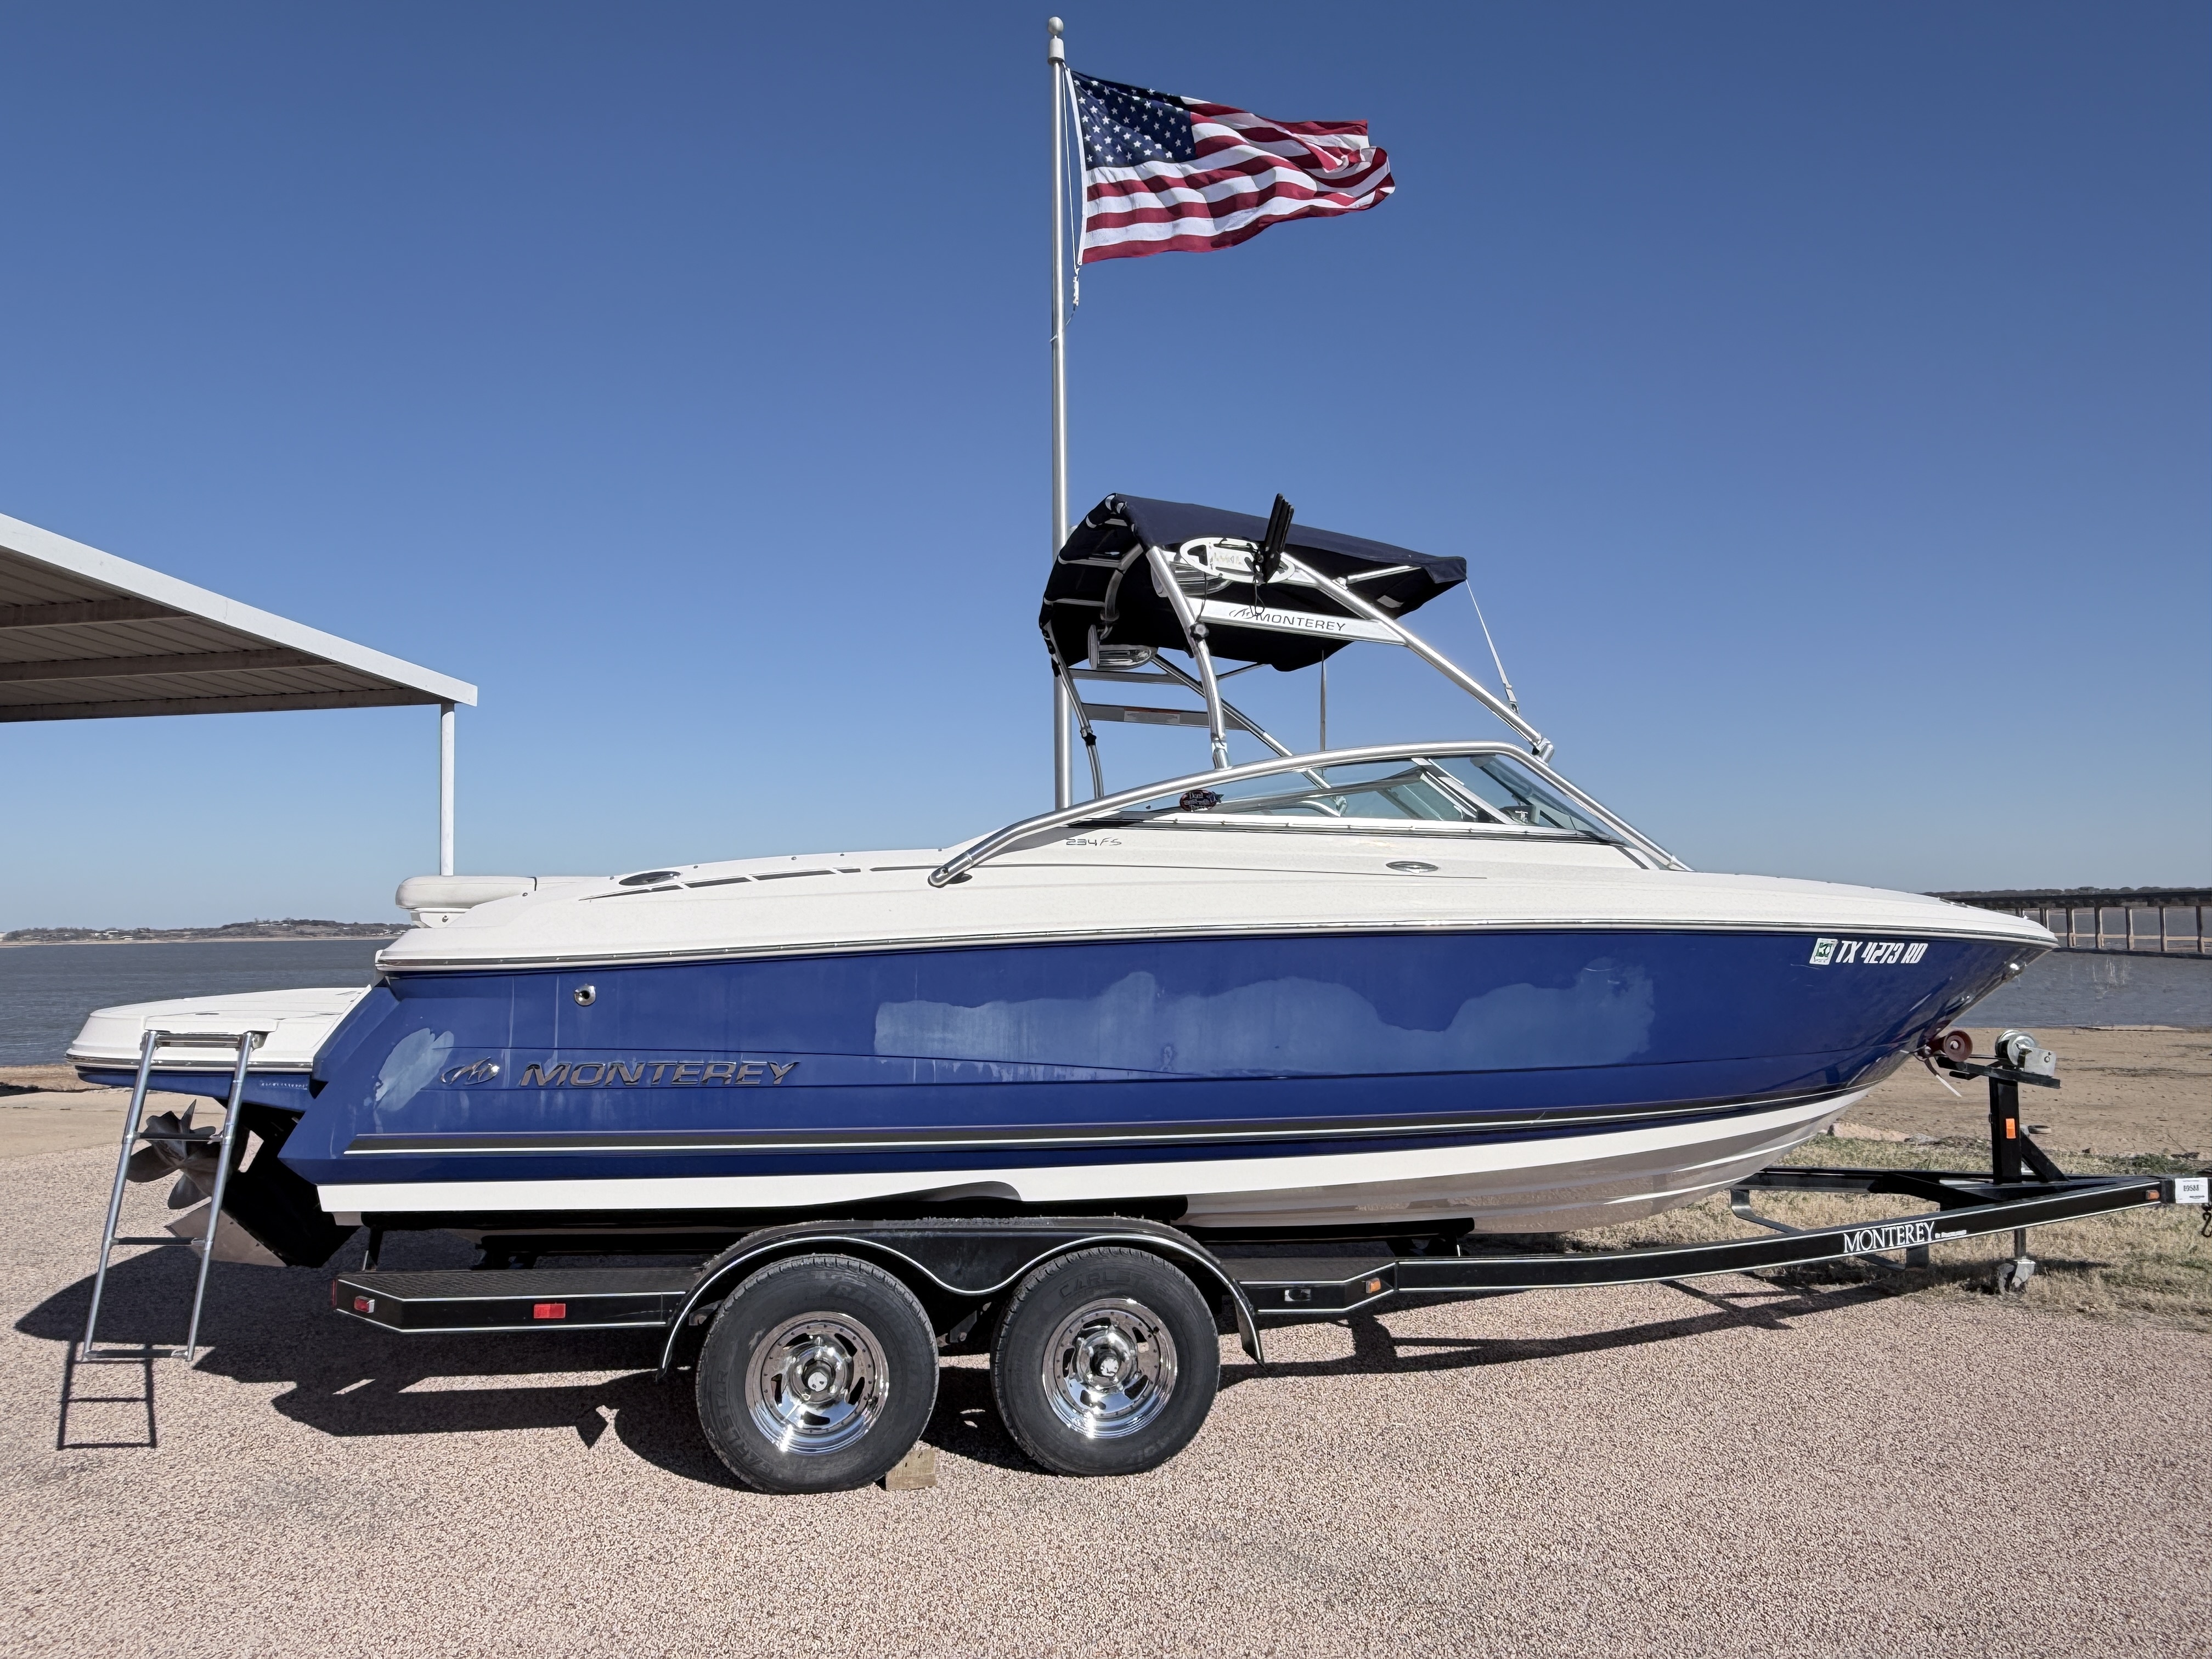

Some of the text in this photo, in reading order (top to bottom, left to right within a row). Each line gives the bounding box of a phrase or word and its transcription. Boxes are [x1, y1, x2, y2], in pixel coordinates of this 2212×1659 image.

[1255, 613, 1346, 631] MONTEREY
[1836, 940, 1863, 963] TX
[1861, 942, 1905, 964] 4273
[520, 1062, 800, 1087] MONTEREY
[1843, 1221, 1935, 1253] MONTEREY
